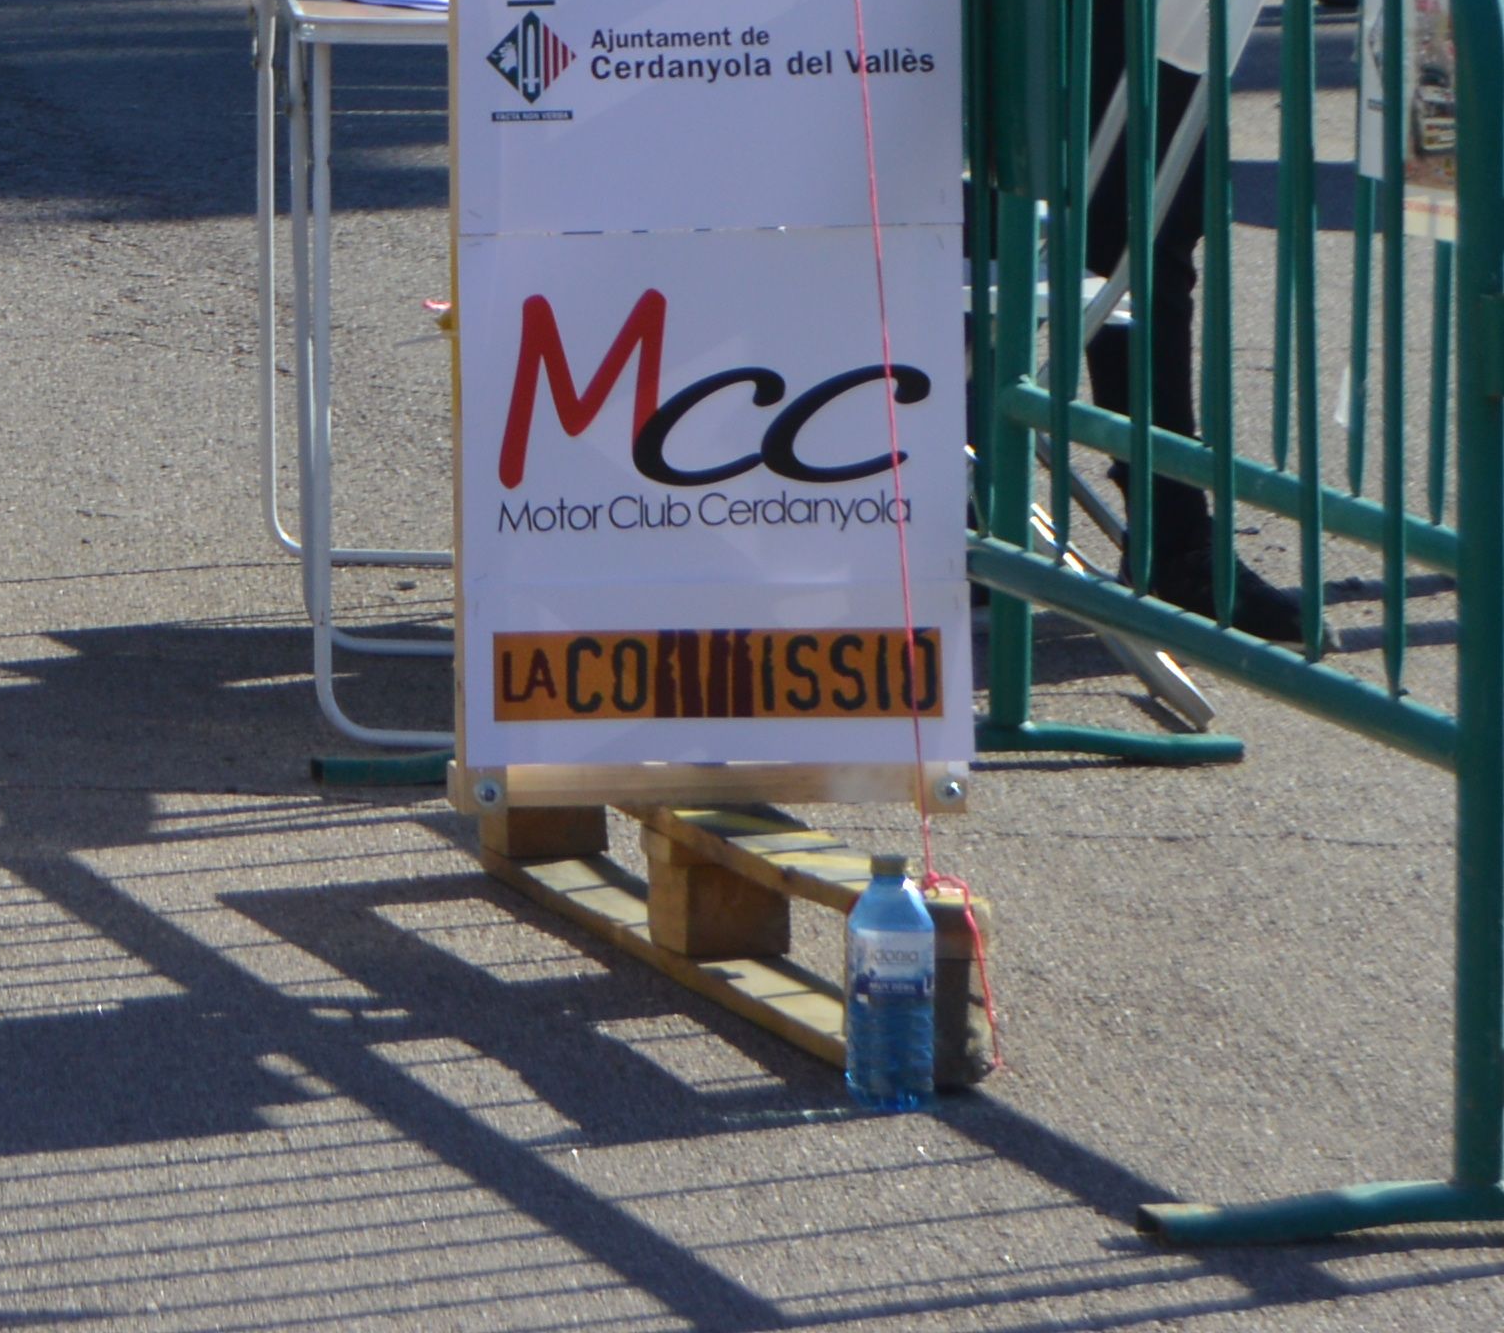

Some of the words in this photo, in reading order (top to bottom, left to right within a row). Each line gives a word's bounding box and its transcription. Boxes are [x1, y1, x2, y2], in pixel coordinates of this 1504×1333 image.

[589, 27, 735, 54] Ajuntament
[738, 26, 770, 47] de
[589, 52, 773, 84] Cerdanyola
[786, 49, 834, 76] del
[844, 44, 936, 74] Vallès
[497, 499, 604, 534] Motor
[608, 492, 691, 531] Club
[698, 489, 911, 534] Cerdanyola
[501, 647, 557, 704] LA
